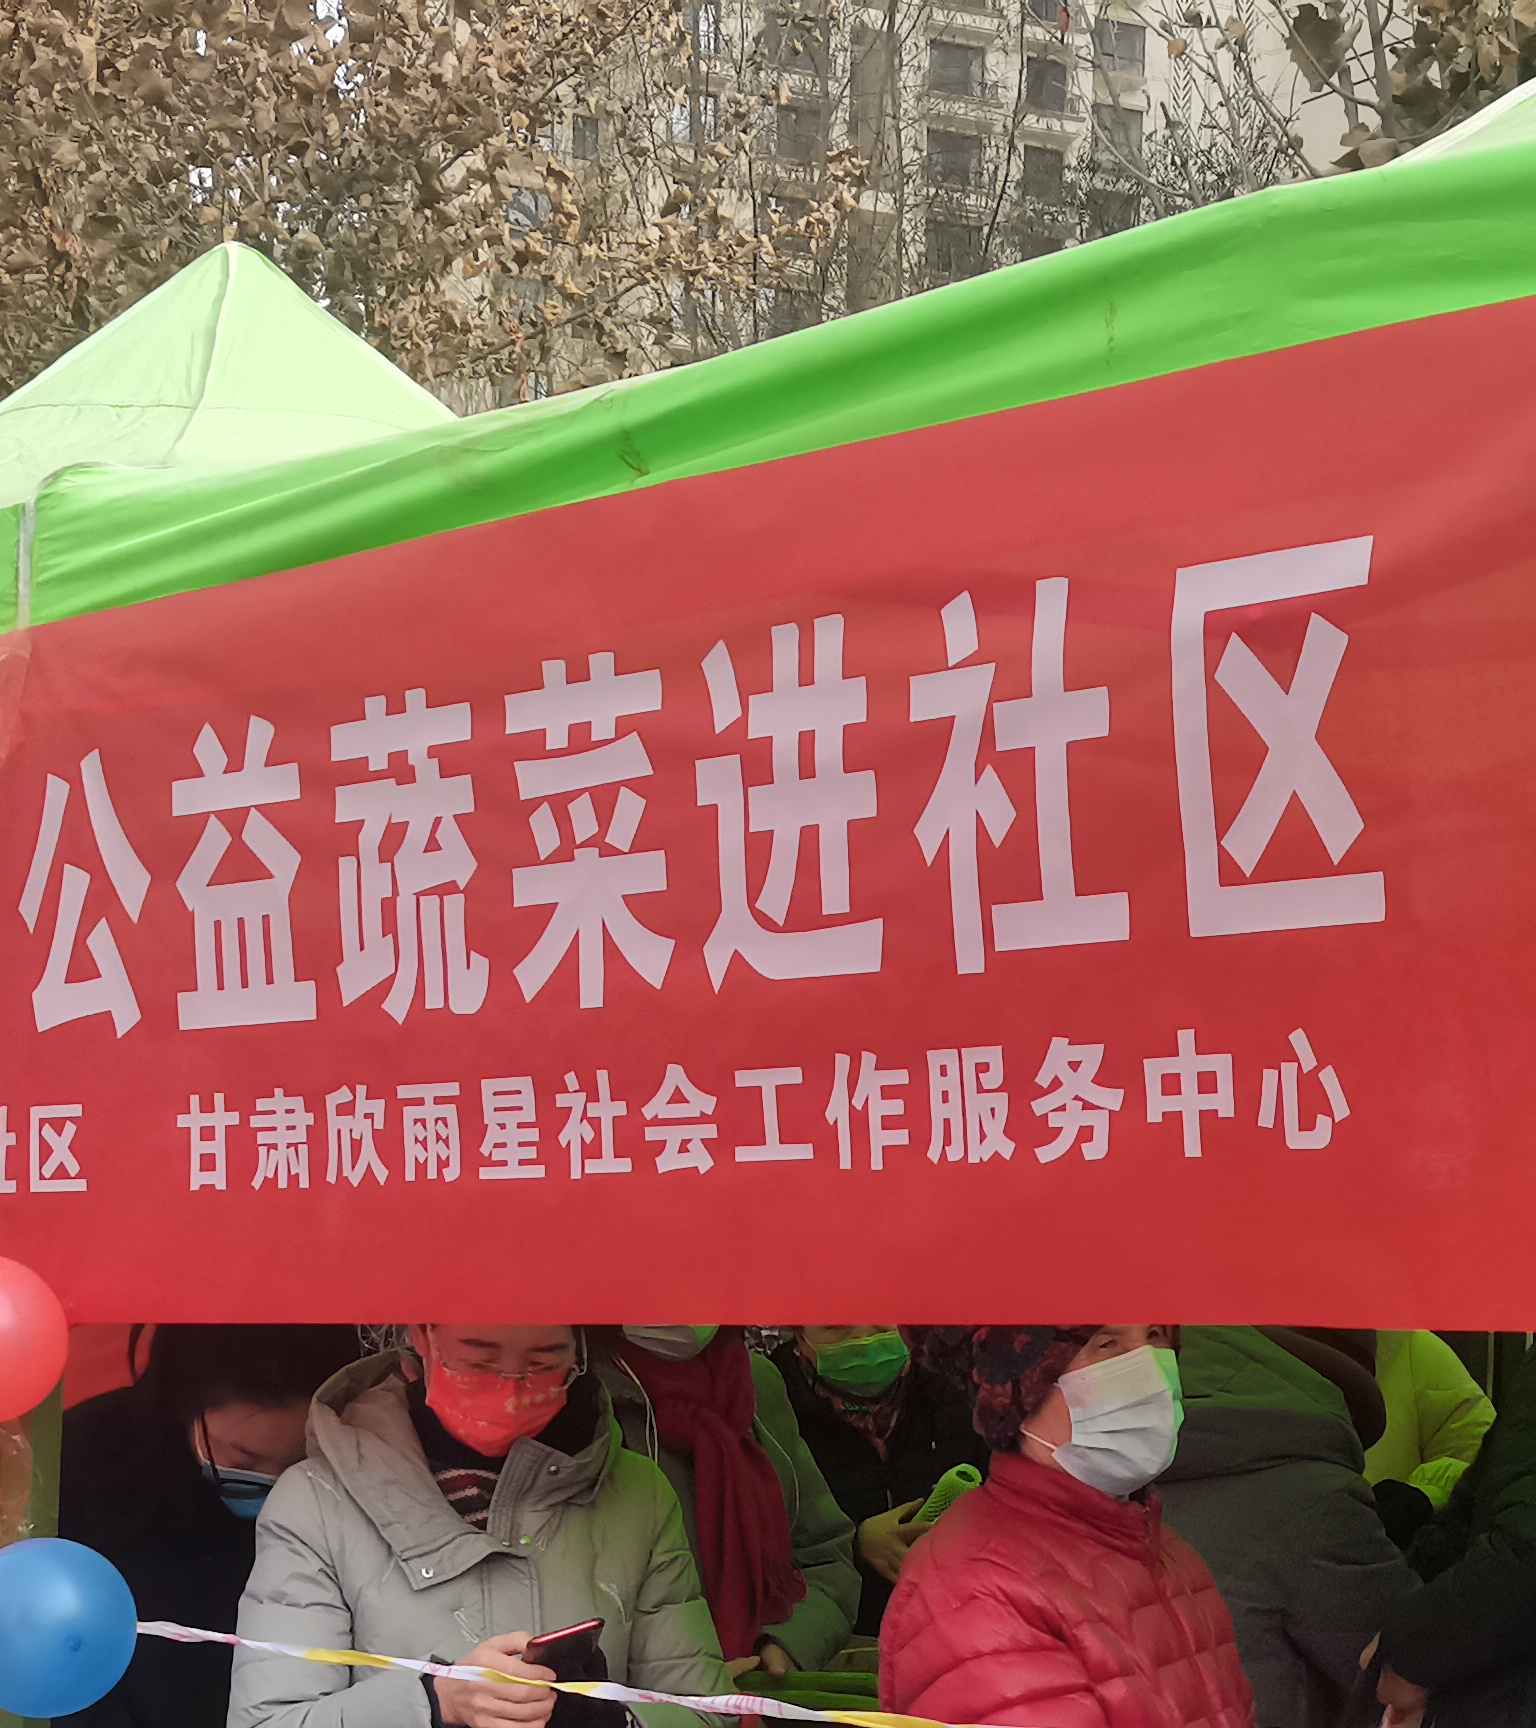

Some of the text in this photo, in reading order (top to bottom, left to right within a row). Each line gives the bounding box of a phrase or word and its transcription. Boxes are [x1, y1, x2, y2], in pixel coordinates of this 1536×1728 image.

[18, 535, 1385, 1037] 公益蔬菜进社区
[177, 1028, 1349, 1191] 甘肃欣雨星社会工作服务中心
